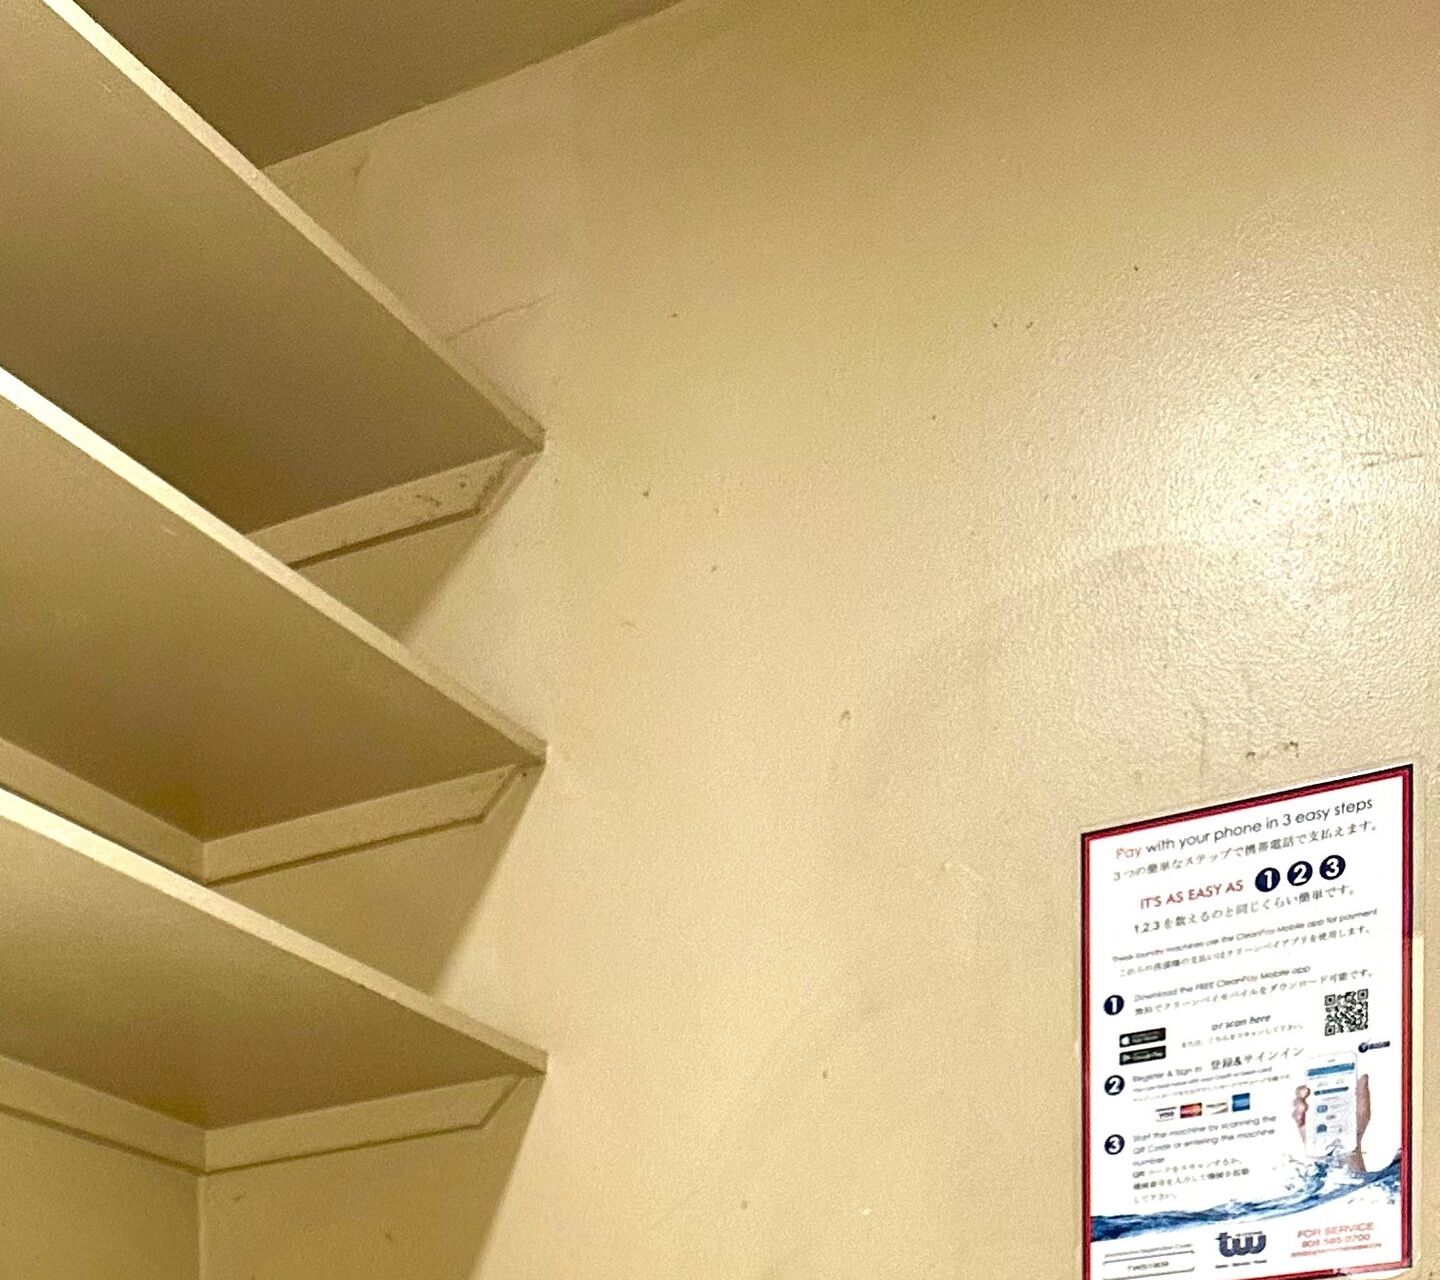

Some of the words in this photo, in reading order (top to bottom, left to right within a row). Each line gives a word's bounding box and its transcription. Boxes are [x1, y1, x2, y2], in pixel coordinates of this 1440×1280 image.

[1116, 847, 1142, 859] Pay
[1146, 839, 1175, 852] with
[1179, 833, 1210, 848] your
[1214, 822, 1262, 842] phone
[1266, 817, 1278, 829] in
[1283, 813, 1292, 826] 3
[1295, 808, 1330, 823] easy
[1334, 799, 1373, 815] steps
[1141, 896, 1162, 909] IT'S
[1166, 892, 1184, 904] AS
[1188, 884, 1222, 900] EASY
[1225, 880, 1244, 893] AS
[1211, 1023, 1223, 1031] or
[1225, 1019, 1247, 1029] scan
[1249, 1015, 1271, 1024] here
[1297, 1228, 1321, 1239] FOR
[1325, 1222, 1374, 1235] SERVICE
